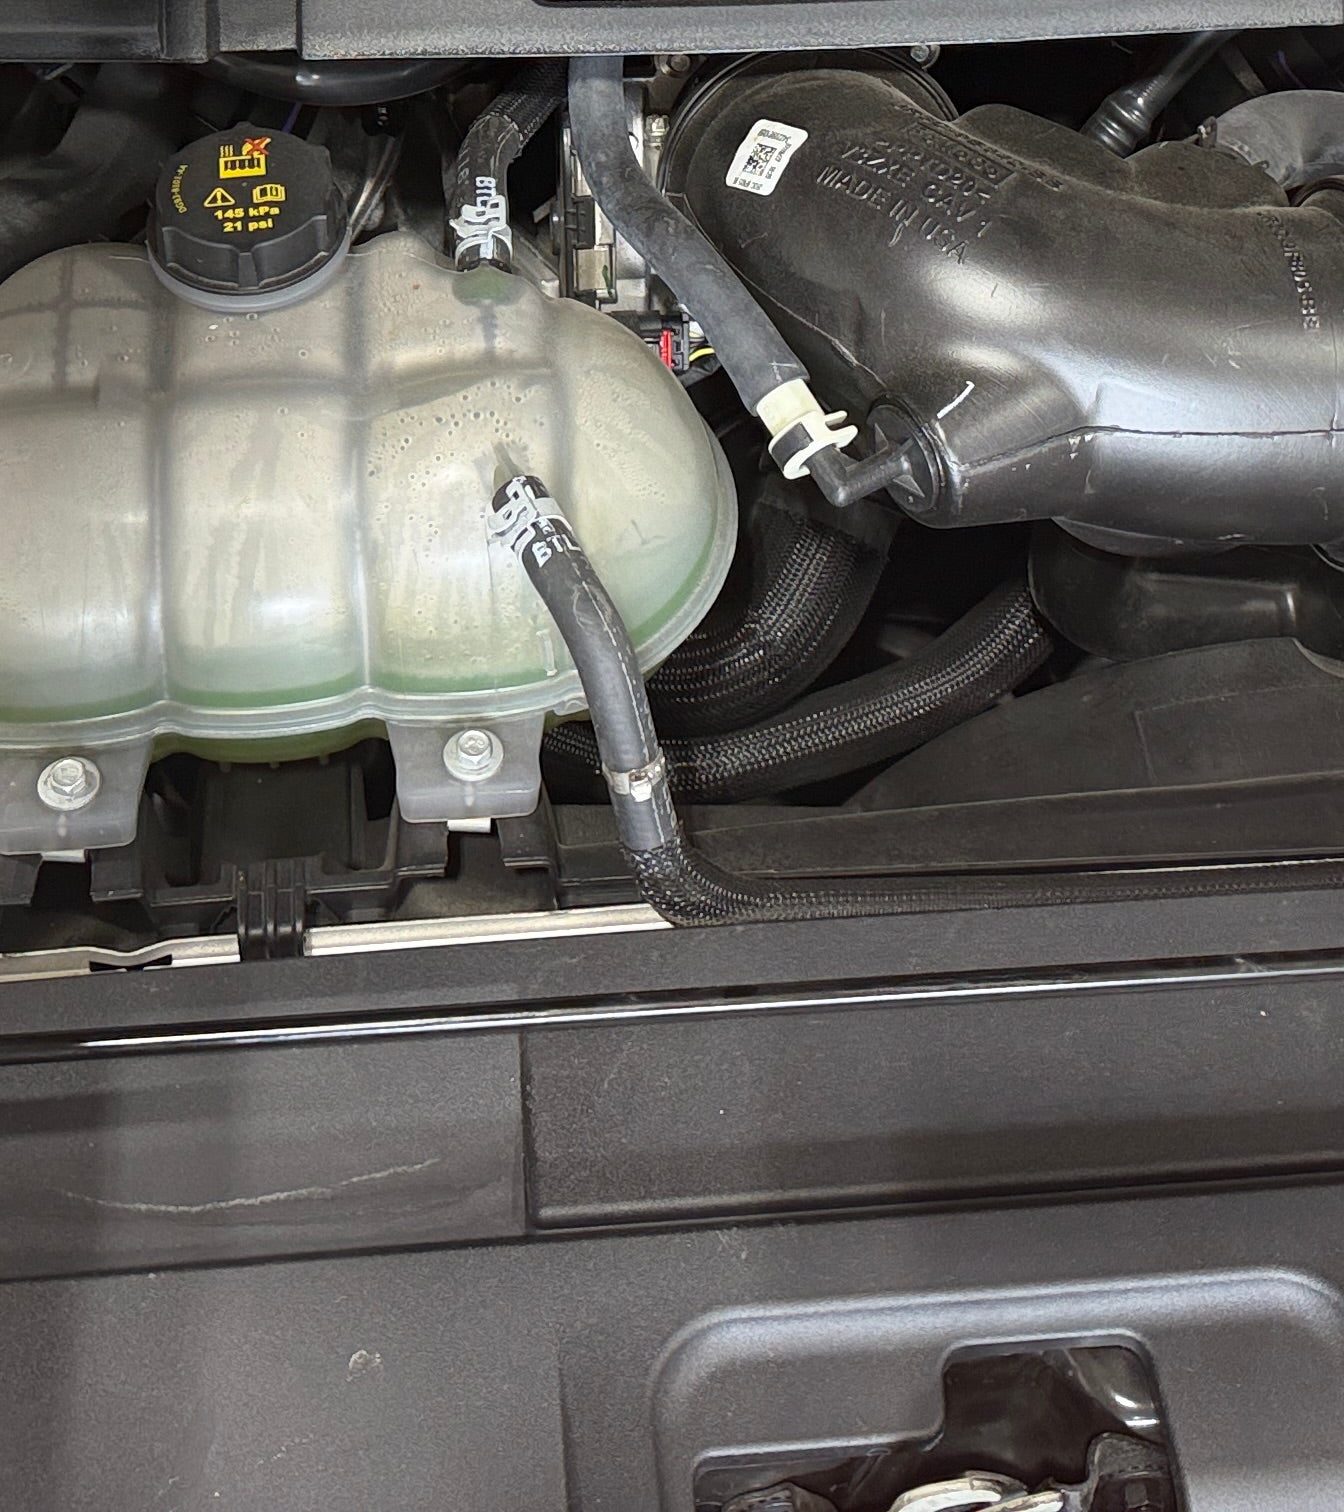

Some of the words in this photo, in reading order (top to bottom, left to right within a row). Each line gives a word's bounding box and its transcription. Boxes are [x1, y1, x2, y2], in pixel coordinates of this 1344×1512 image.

[214, 207, 244, 220] 145
[249, 206, 280, 218] kPa
[816, 166, 892, 210] MADE
[889, 199, 920, 227] IN
[921, 217, 970, 265] USA
[223, 221, 242, 232] 21
[248, 219, 273, 231] psi
